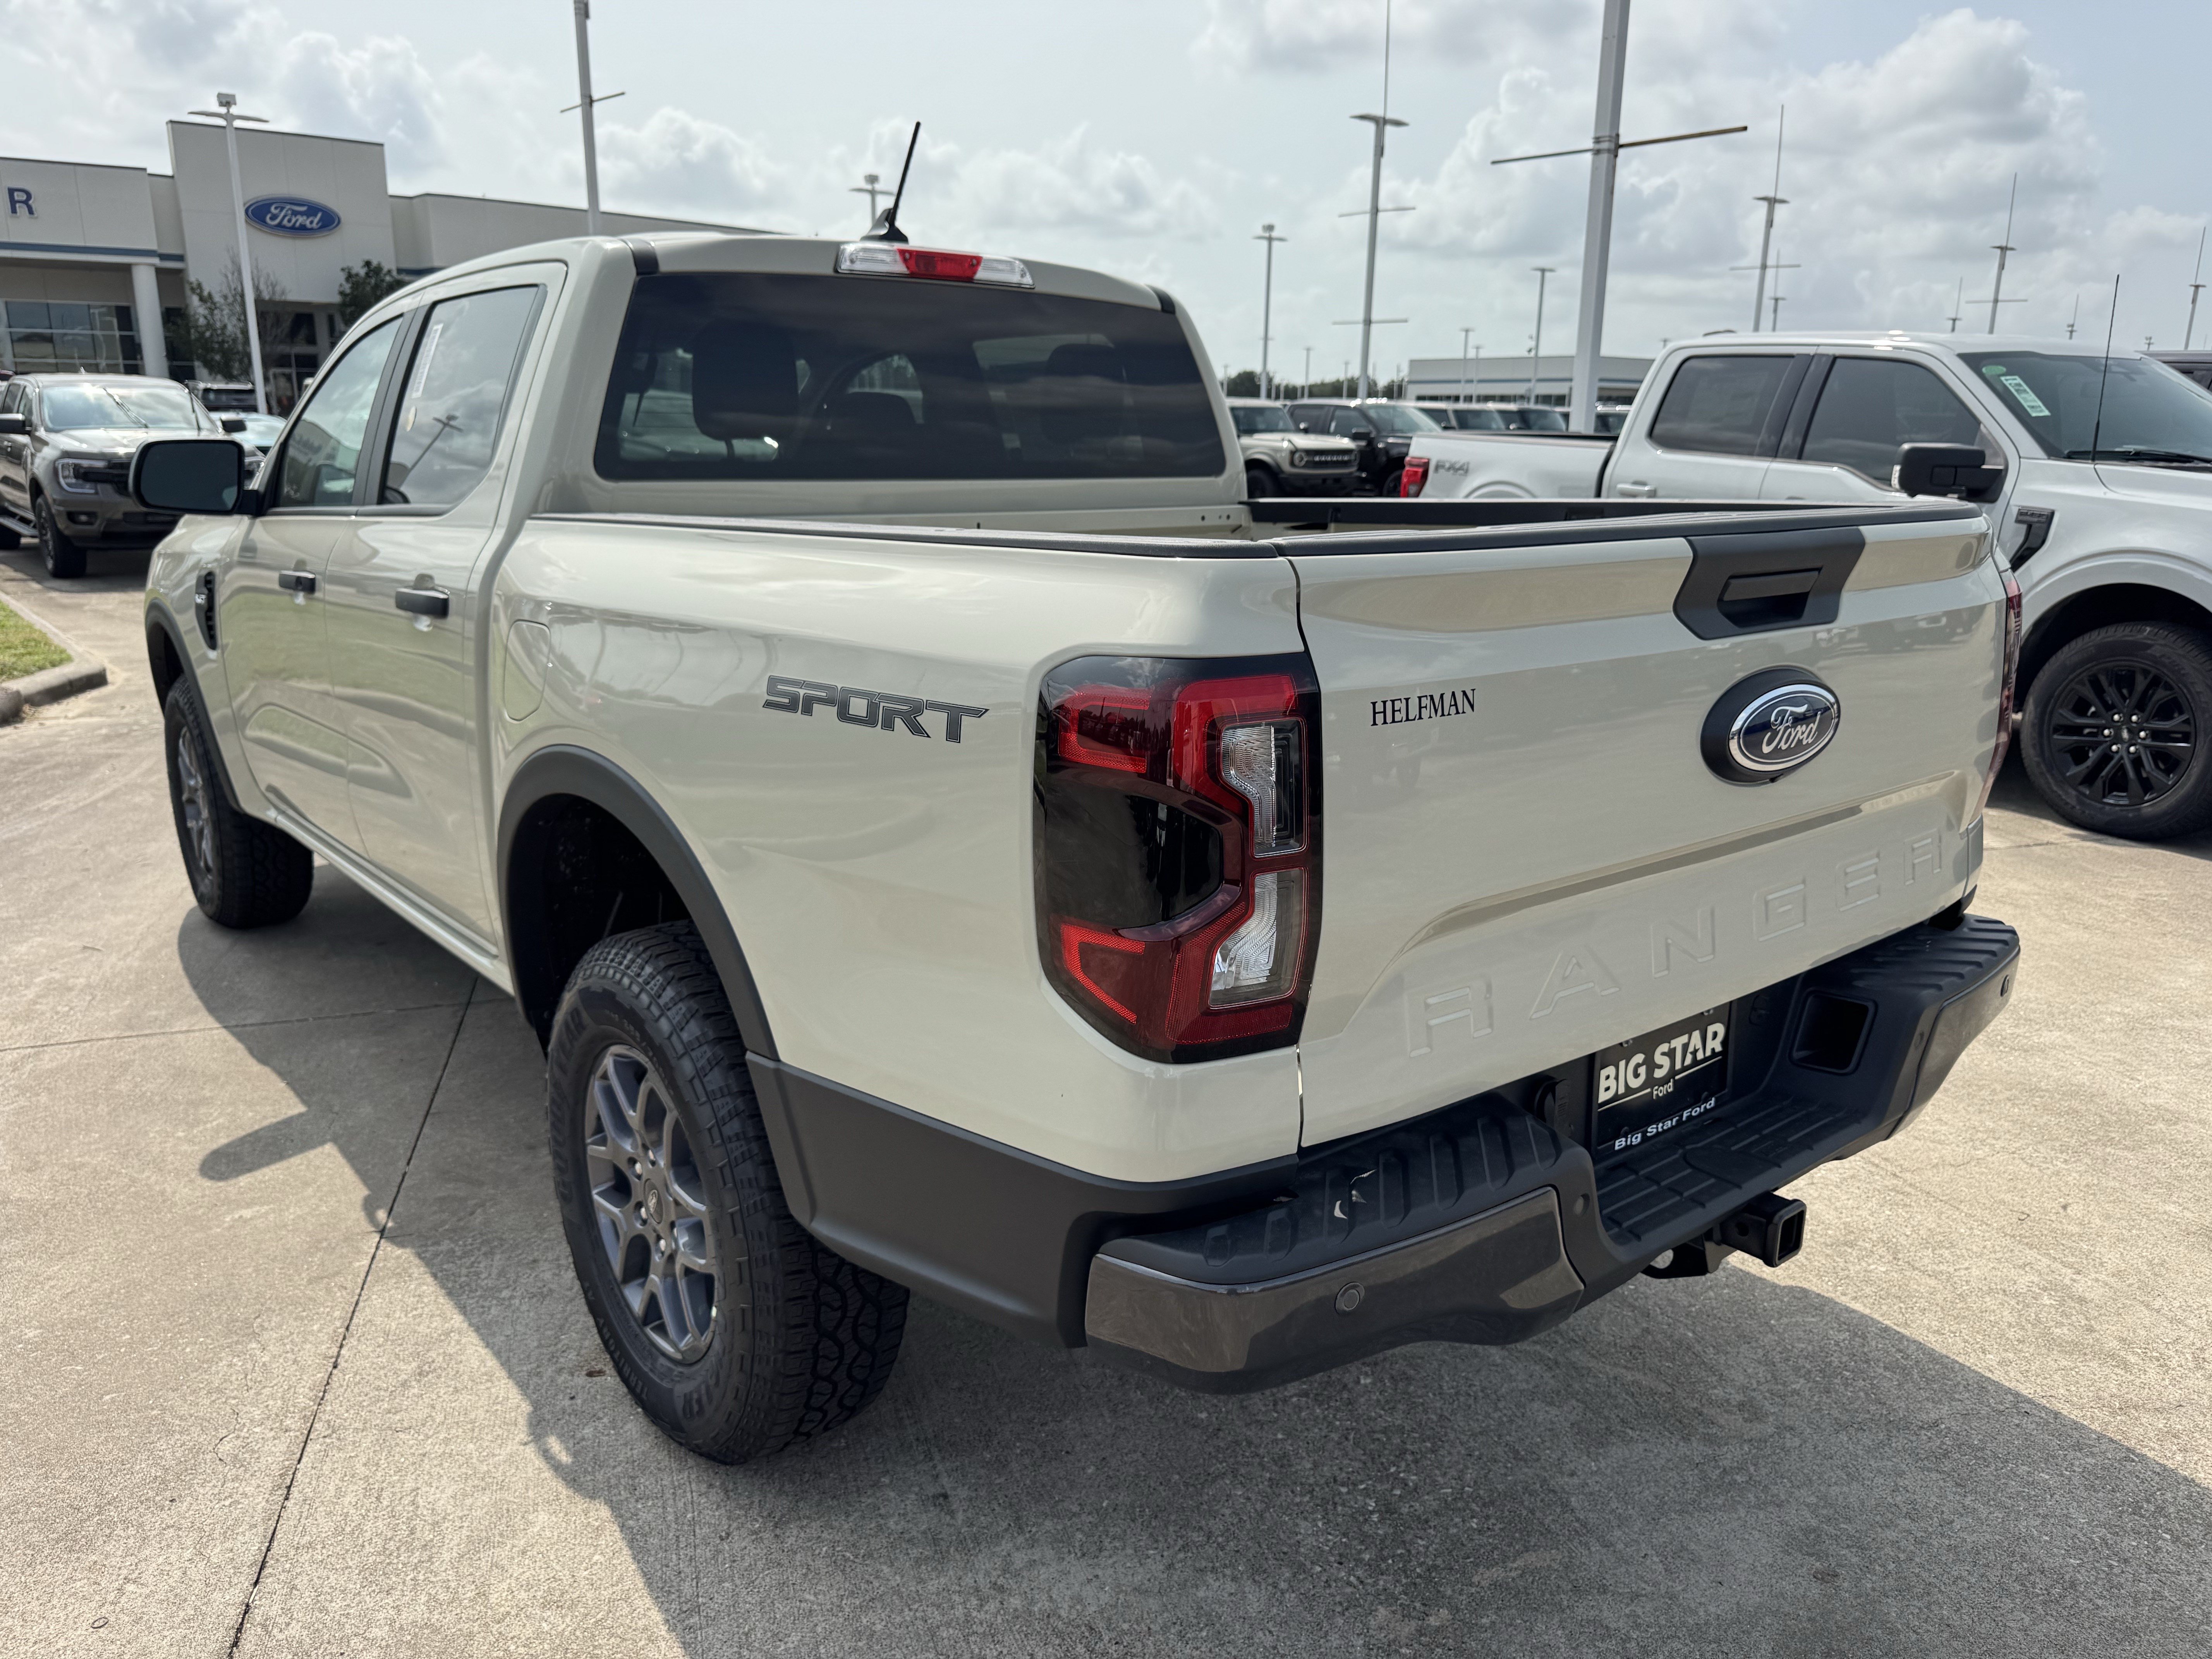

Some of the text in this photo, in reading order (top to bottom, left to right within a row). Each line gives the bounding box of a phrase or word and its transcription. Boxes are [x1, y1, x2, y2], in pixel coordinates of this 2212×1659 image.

[7, 187, 36, 216] R
[266, 203, 322, 229] Ford
[1433, 459, 1470, 476] FX4
[762, 675, 990, 744] SPORT
[1370, 688, 1476, 726] HELFMAN
[1762, 704, 1822, 754] Ford
[1403, 827, 1942, 1058] RANGER
[1597, 1022, 1726, 1104] BIG STAR
[1652, 1078, 1674, 1100] Ford
[1614, 1097, 1716, 1151] Big Star Ford
